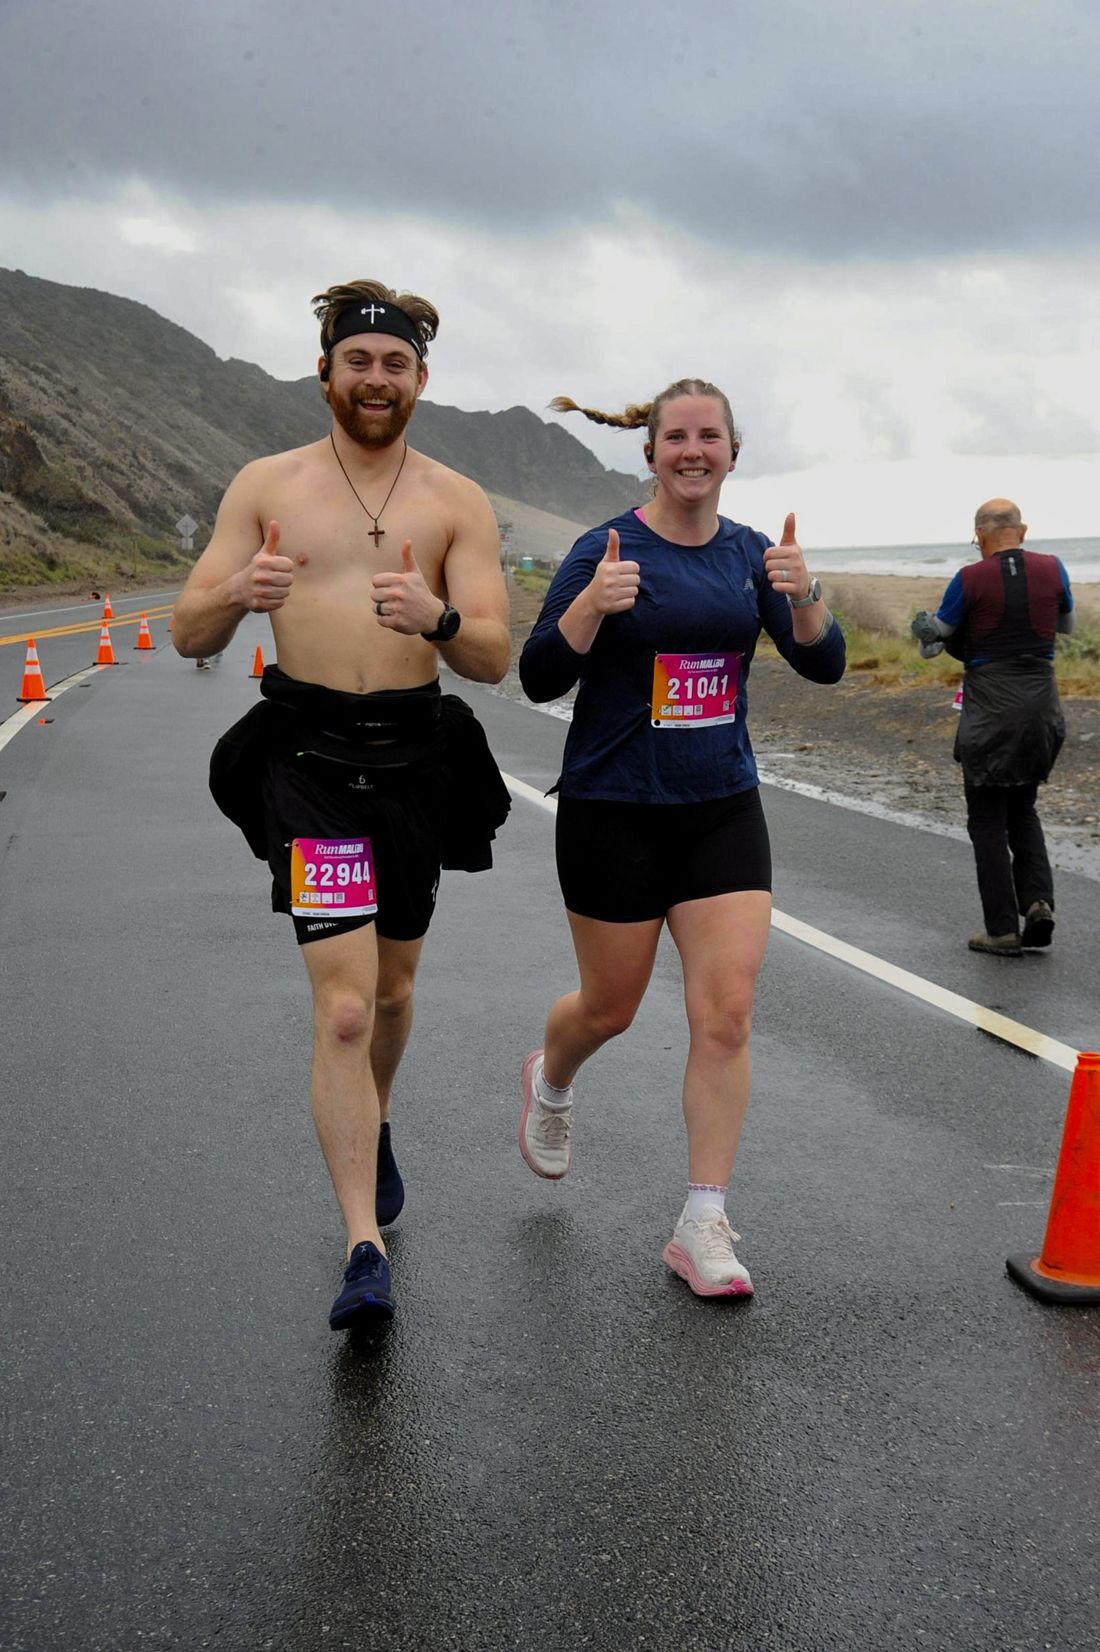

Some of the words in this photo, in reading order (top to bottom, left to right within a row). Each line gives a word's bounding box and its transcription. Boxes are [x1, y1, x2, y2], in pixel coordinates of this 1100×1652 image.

[667, 674, 728, 699] 21041
[304, 861, 370, 886] 22944
[307, 922, 324, 932] FAITH
